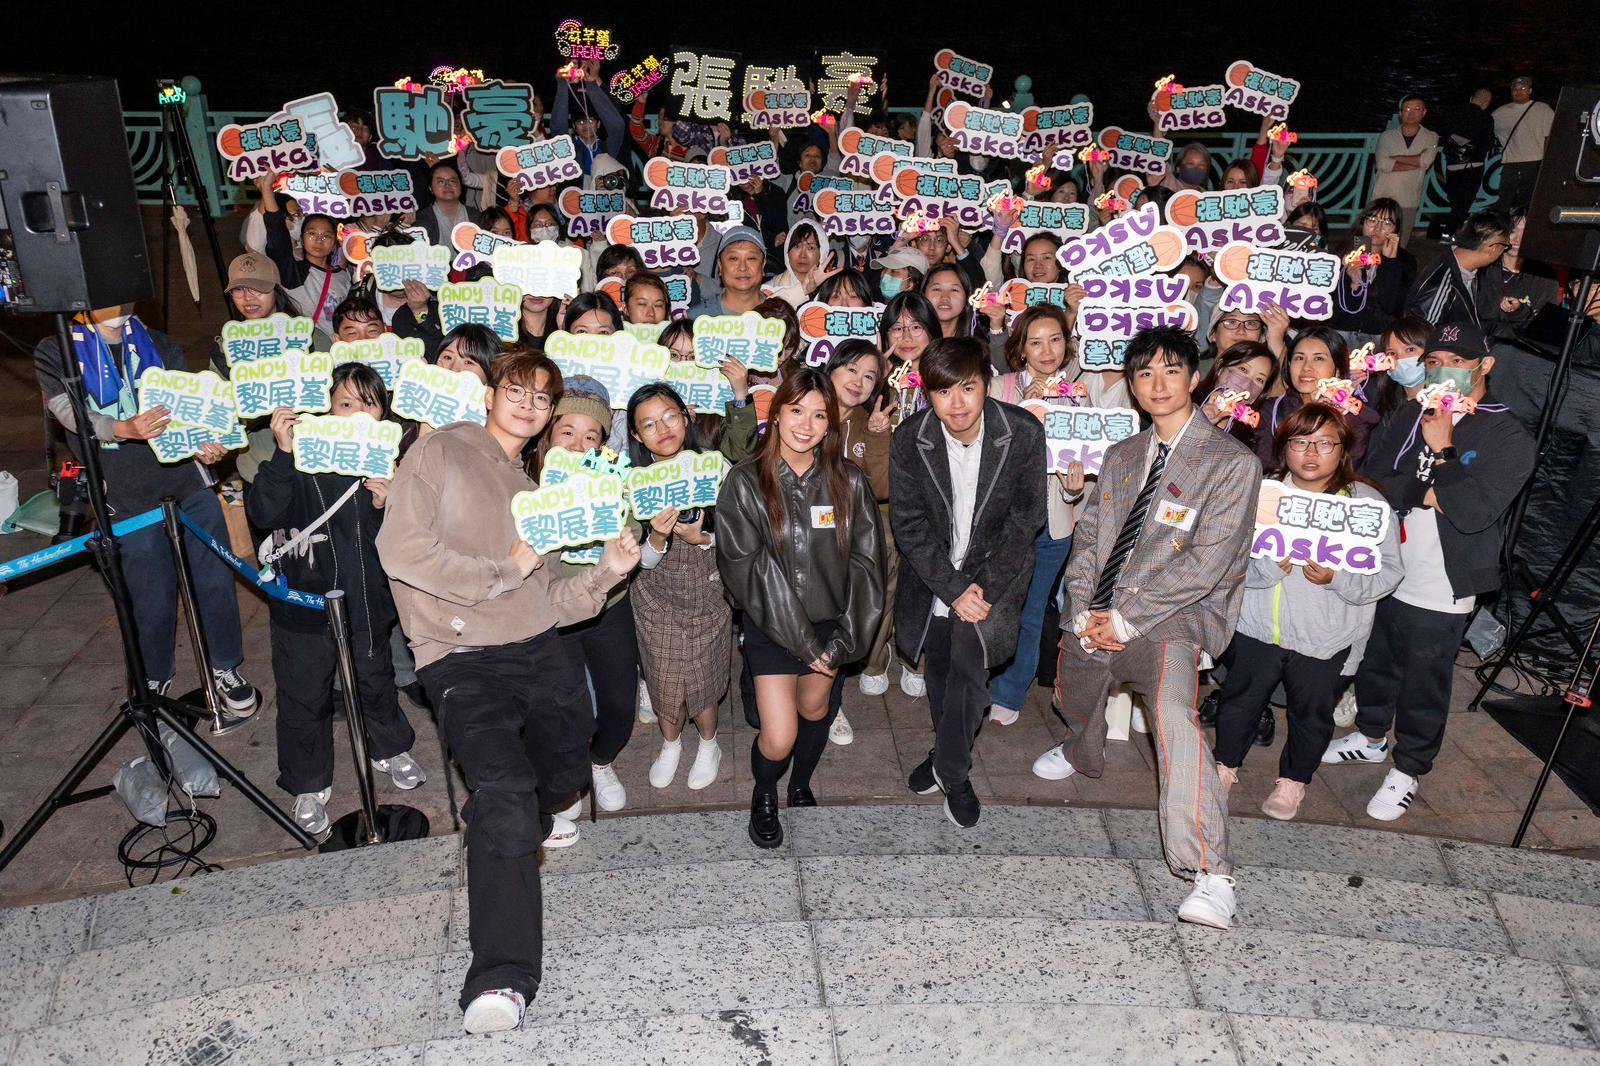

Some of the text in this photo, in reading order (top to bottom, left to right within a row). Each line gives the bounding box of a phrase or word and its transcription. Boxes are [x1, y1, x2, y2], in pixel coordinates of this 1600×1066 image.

[571, 44, 604, 59] IRENE
[629, 67, 663, 97] IRENE
[670, 51, 736, 121] 張
[817, 51, 878, 115] 豪
[937, 70, 983, 95] Aska
[1244, 71, 1298, 101] 張馳豪
[1170, 88, 1223, 109] 張馳豪
[1226, 88, 1286, 119] Aska
[379, 90, 449, 155] 馳
[466, 84, 534, 148] 豪
[756, 111, 809, 126] Aska
[964, 110, 1021, 137] 張馳豪
[1036, 106, 1089, 129] 張馳豪
[1161, 110, 1224, 128] Aska
[240, 119, 303, 152] 張馳豪
[952, 130, 1016, 156] Aska
[1026, 129, 1089, 149] Aska
[1116, 133, 1171, 157] 張馳豪
[235, 148, 309, 178] Aska
[515, 138, 573, 168] 張馳豪
[356, 172, 410, 193] 張馳豪
[515, 161, 579, 190] Aska
[666, 166, 728, 189] 張馳豪
[916, 174, 981, 201] 張馳豪
[299, 196, 347, 215] ska
[353, 195, 415, 214] Aska
[654, 188, 727, 211] Aska
[901, 197, 979, 222] Aska
[1195, 189, 1279, 222] 張馳豪
[629, 219, 695, 243] 張馳豪
[824, 214, 892, 233] Aska
[1020, 205, 1086, 231] 張馳豪
[1061, 206, 1155, 266] Aska
[1185, 222, 1281, 249] Aska
[376, 249, 416, 262] ANDY
[425, 249, 447, 261] LAI
[644, 245, 697, 264] ska
[1246, 252, 1336, 288] 張馳豪
[442, 286, 517, 304] ANDY LAI
[1082, 278, 1185, 303] Aska
[1224, 282, 1329, 316] Aska
[227, 321, 309, 338] ANDY LAI
[698, 319, 782, 337] ANDY LAI
[336, 342, 421, 361] ANDY LAI
[552, 336, 664, 368] ANDY LAI
[235, 357, 328, 381] ANDY LAI
[405, 362, 458, 394] ANDY
[146, 371, 235, 399] ANDY LA
[300, 420, 397, 443] ANDY LAI
[1044, 411, 1133, 442] 張馳豪
[632, 456, 719, 487] ANDY LAI
[519, 479, 618, 515] ANDY LAI
[1279, 494, 1383, 538] 張馳豪
[1251, 527, 1377, 570] Aska
